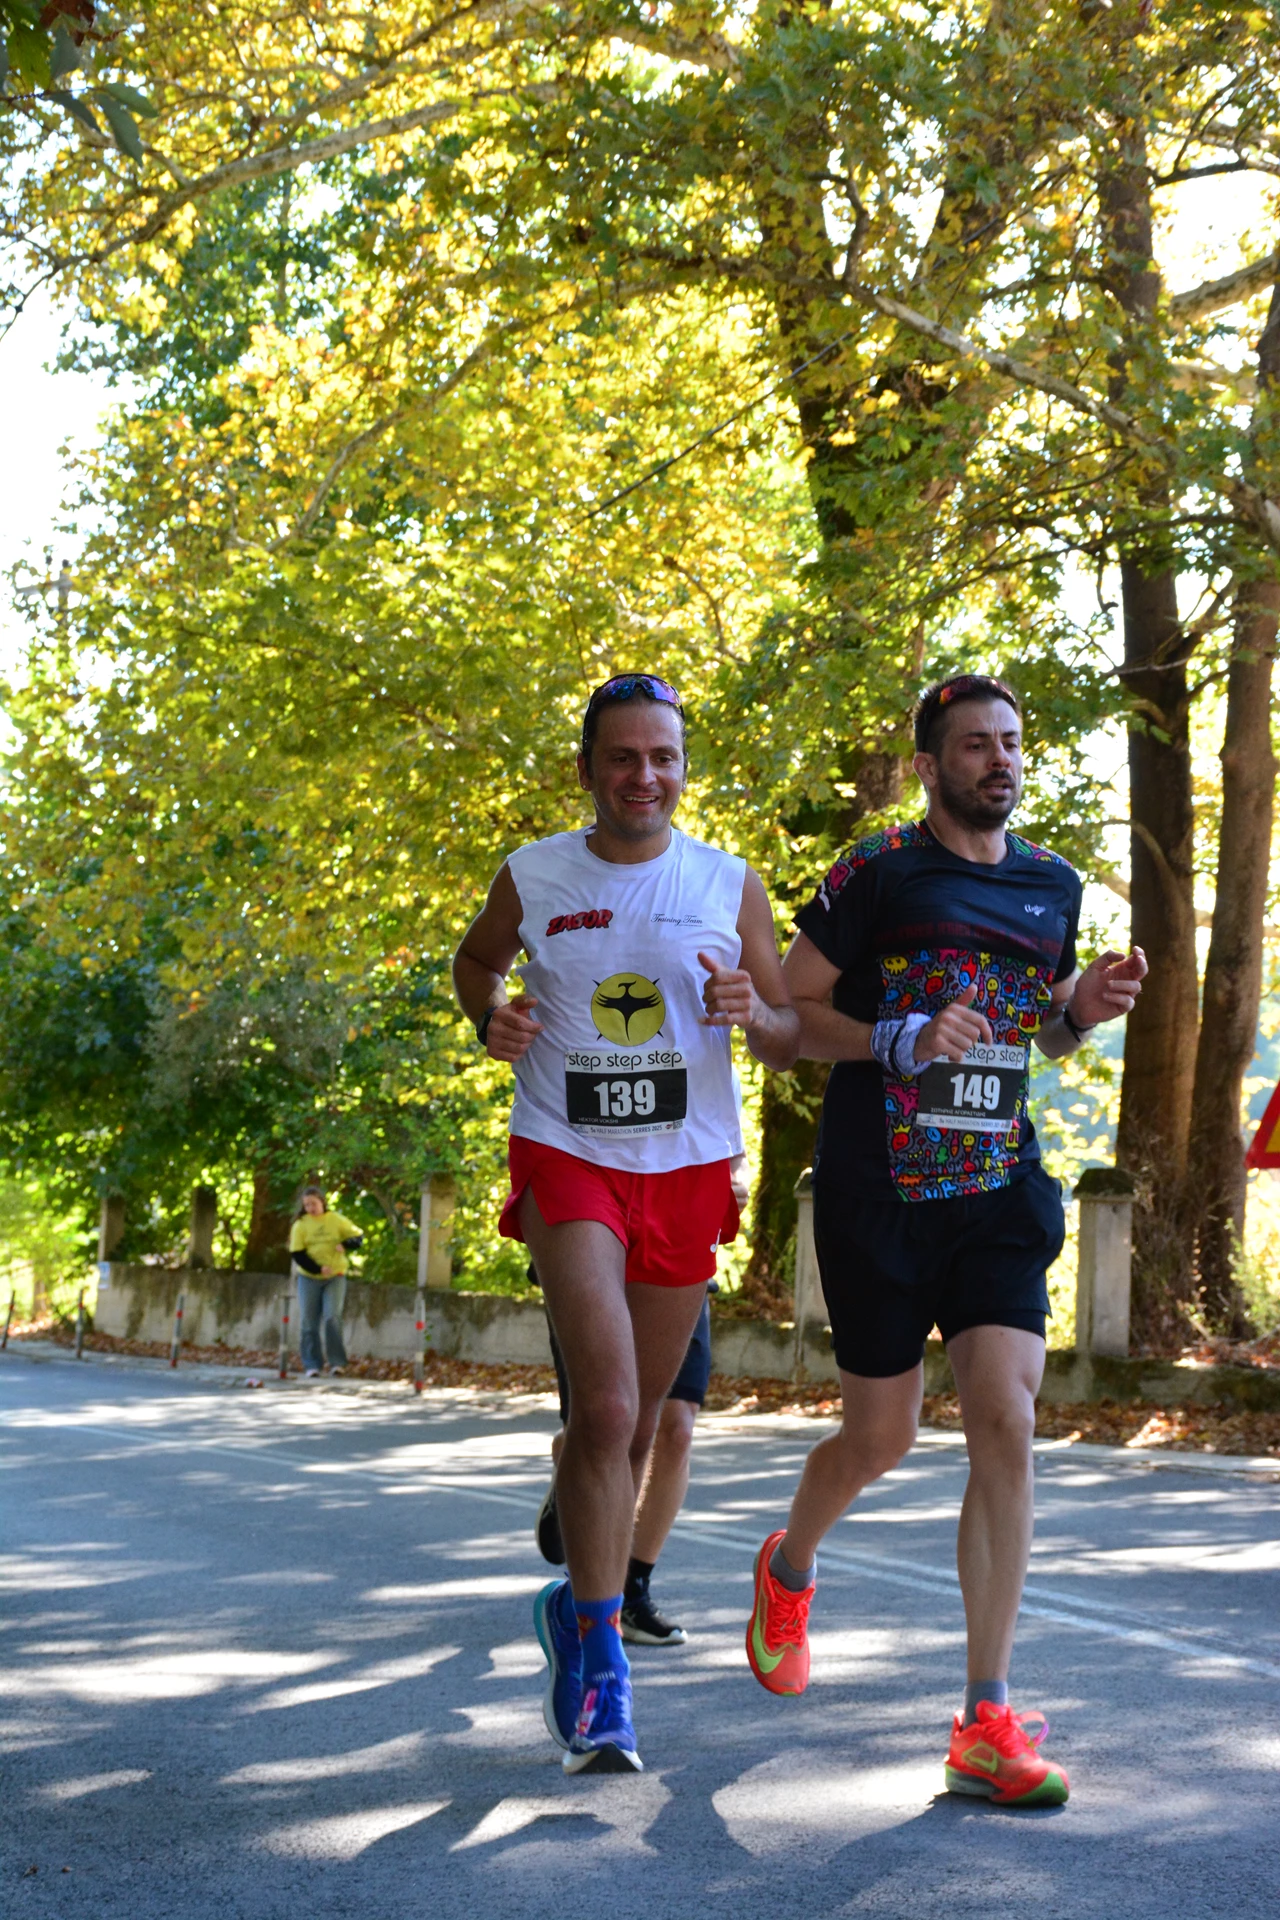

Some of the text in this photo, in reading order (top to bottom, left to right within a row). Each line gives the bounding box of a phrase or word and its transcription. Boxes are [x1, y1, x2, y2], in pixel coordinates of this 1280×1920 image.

[546, 909, 613, 937] ZAGOR
[650, 913, 703, 927] Training Team
[568, 1050, 683, 1071] step step step
[965, 1045, 1024, 1067] step step
[593, 1078, 656, 1117] 139
[950, 1072, 1001, 1111] 149
[632, 1126, 651, 1134] SERRES
